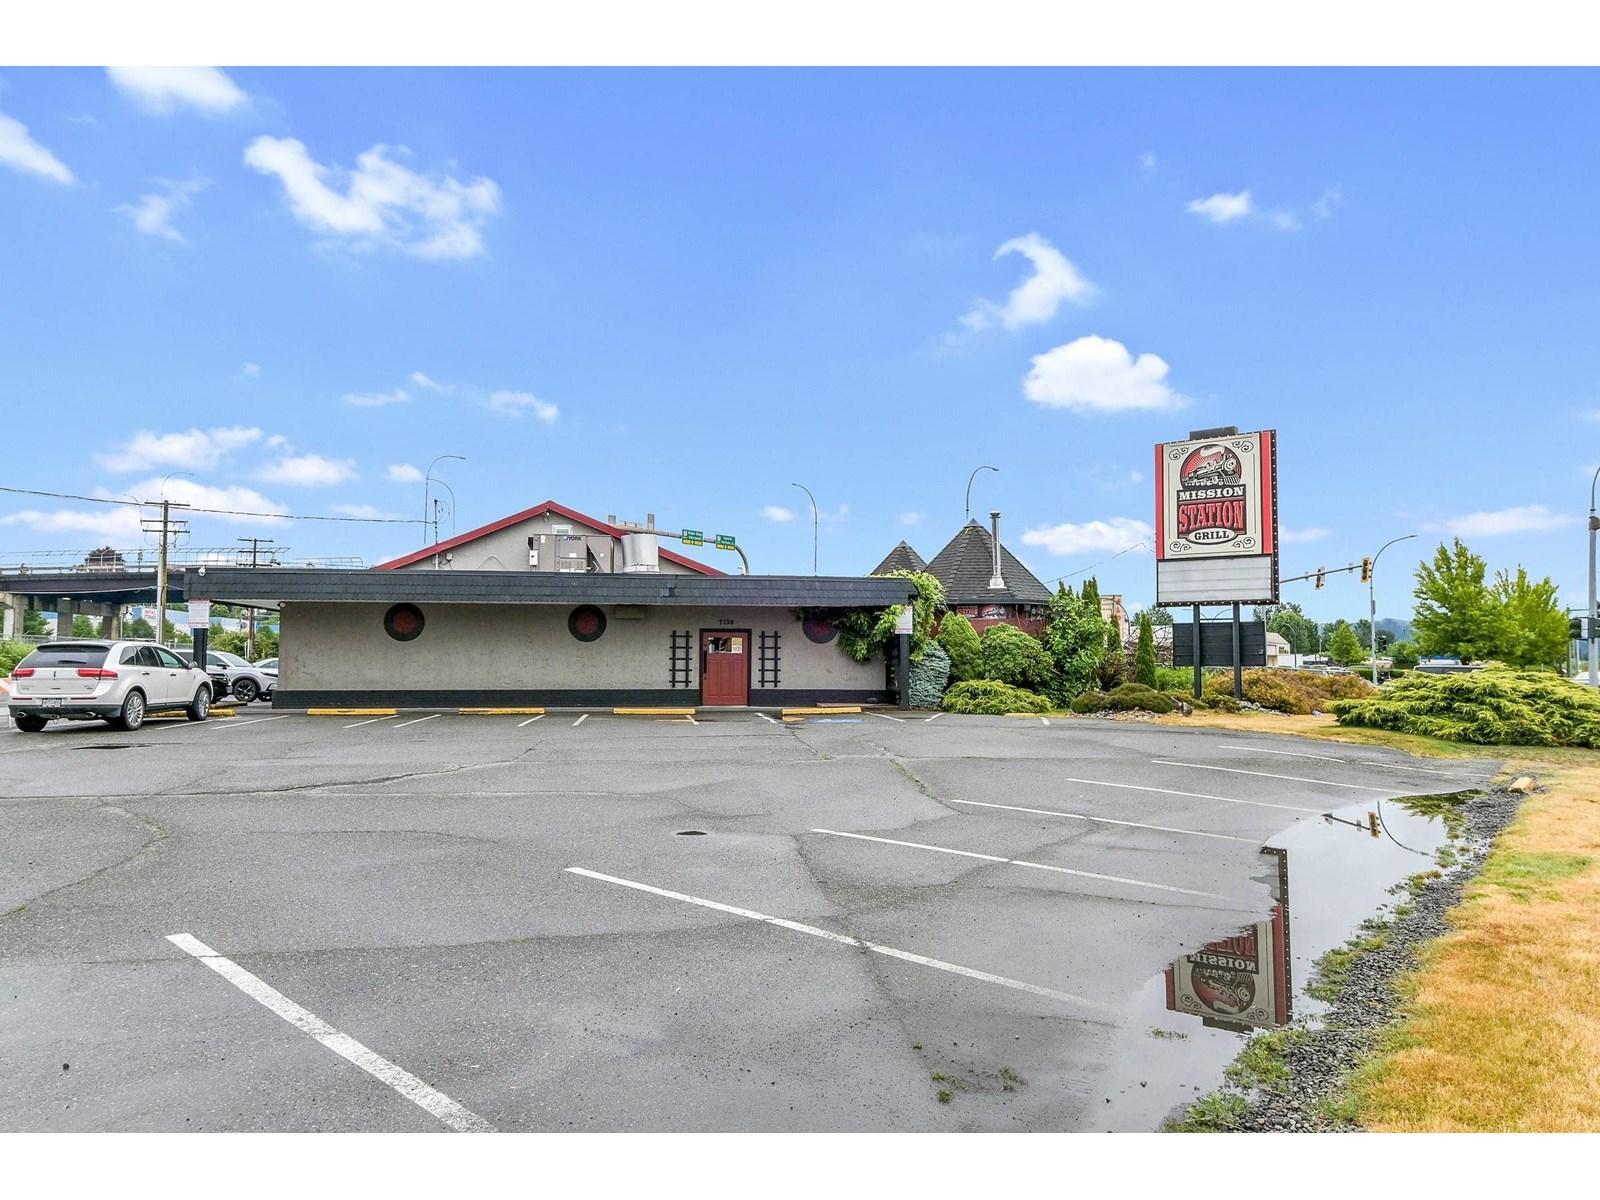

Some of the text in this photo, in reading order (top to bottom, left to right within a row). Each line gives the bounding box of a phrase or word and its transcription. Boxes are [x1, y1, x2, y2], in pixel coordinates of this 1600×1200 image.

[1179, 486, 1244, 501] MISSION
[1179, 501, 1244, 533] STATION
[1194, 530, 1230, 541] GRILL
